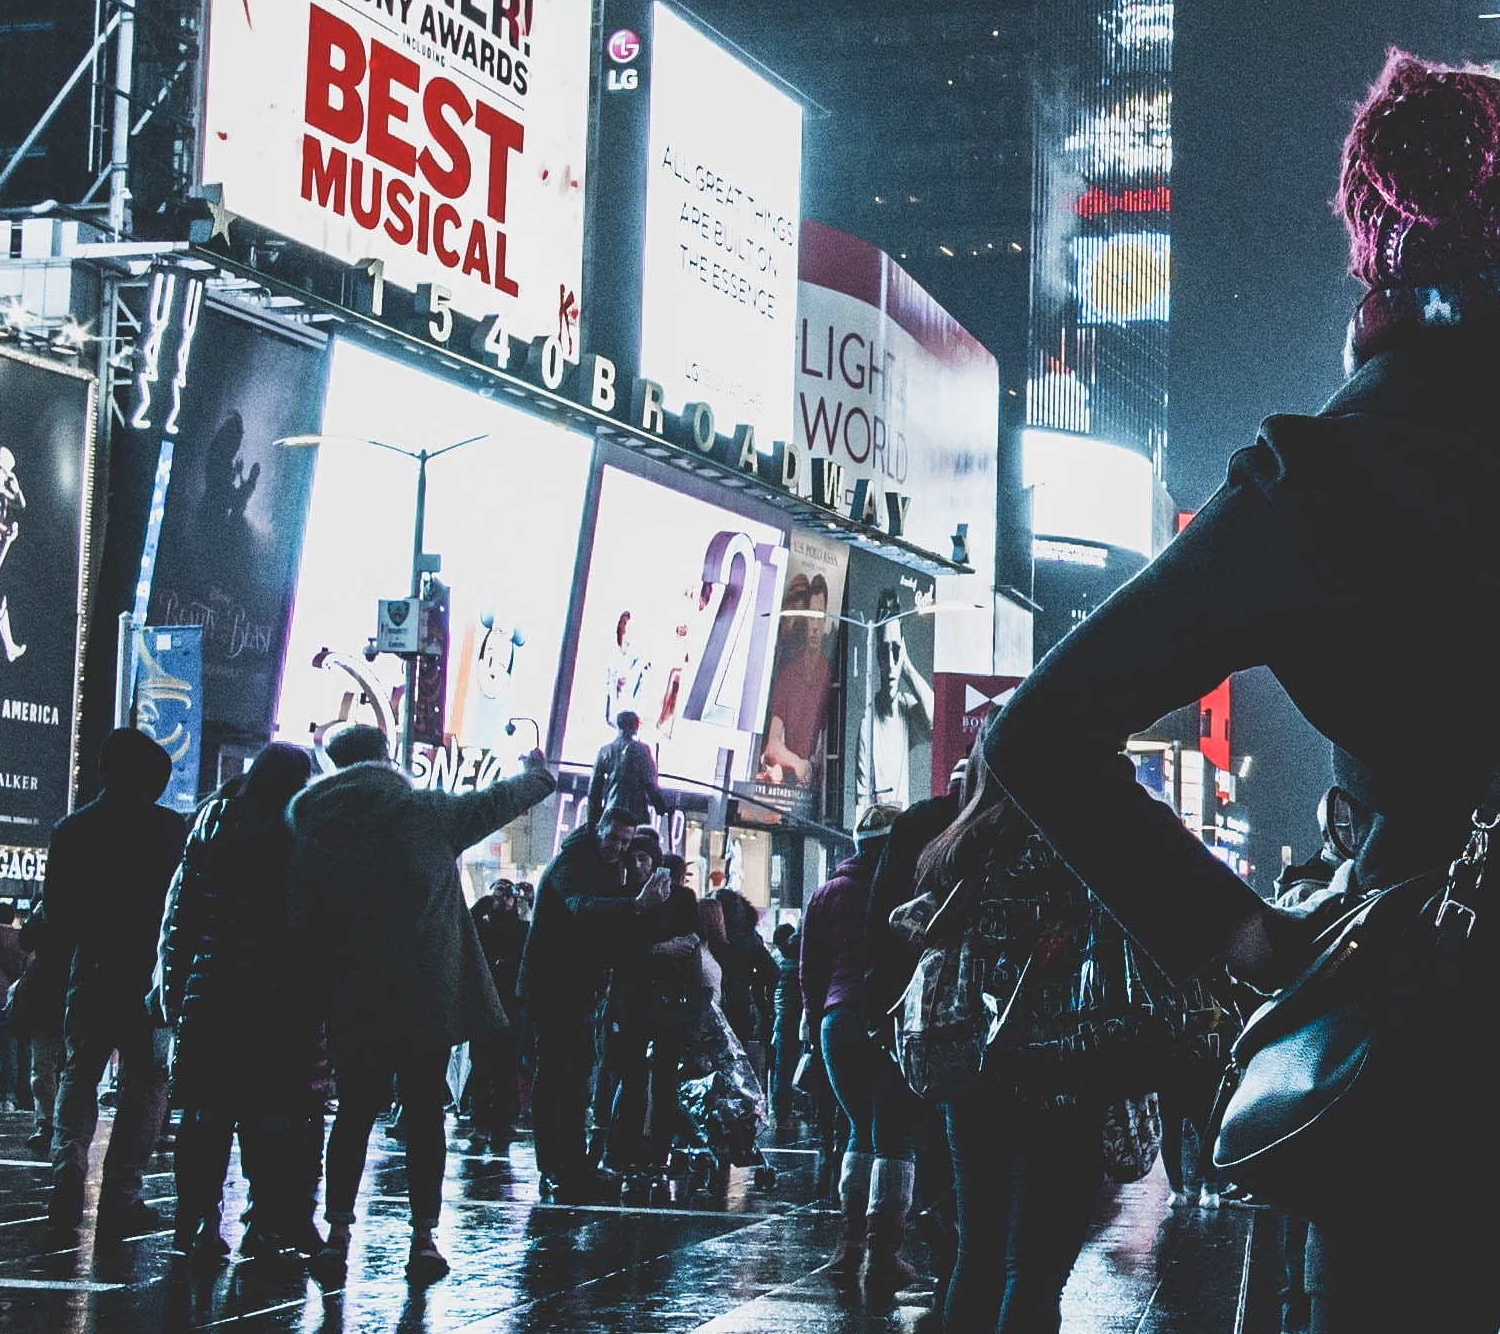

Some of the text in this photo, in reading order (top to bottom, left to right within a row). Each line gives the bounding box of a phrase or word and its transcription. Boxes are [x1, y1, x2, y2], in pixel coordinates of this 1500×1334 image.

[402, 33, 446, 68] INCLUDING
[419, 4, 529, 97] AWARDS
[608, 70, 638, 91] LG
[303, 1, 525, 224] BEST
[300, 133, 519, 298] MUSICAL
[662, 143, 794, 247] ALL GREAT THINGS
[679, 202, 777, 278] ARE BUILT ON
[679, 243, 775, 320] THE ESSENCE
[799, 392, 908, 485] WORLD
[2, 699, 60, 725] AMERICA
